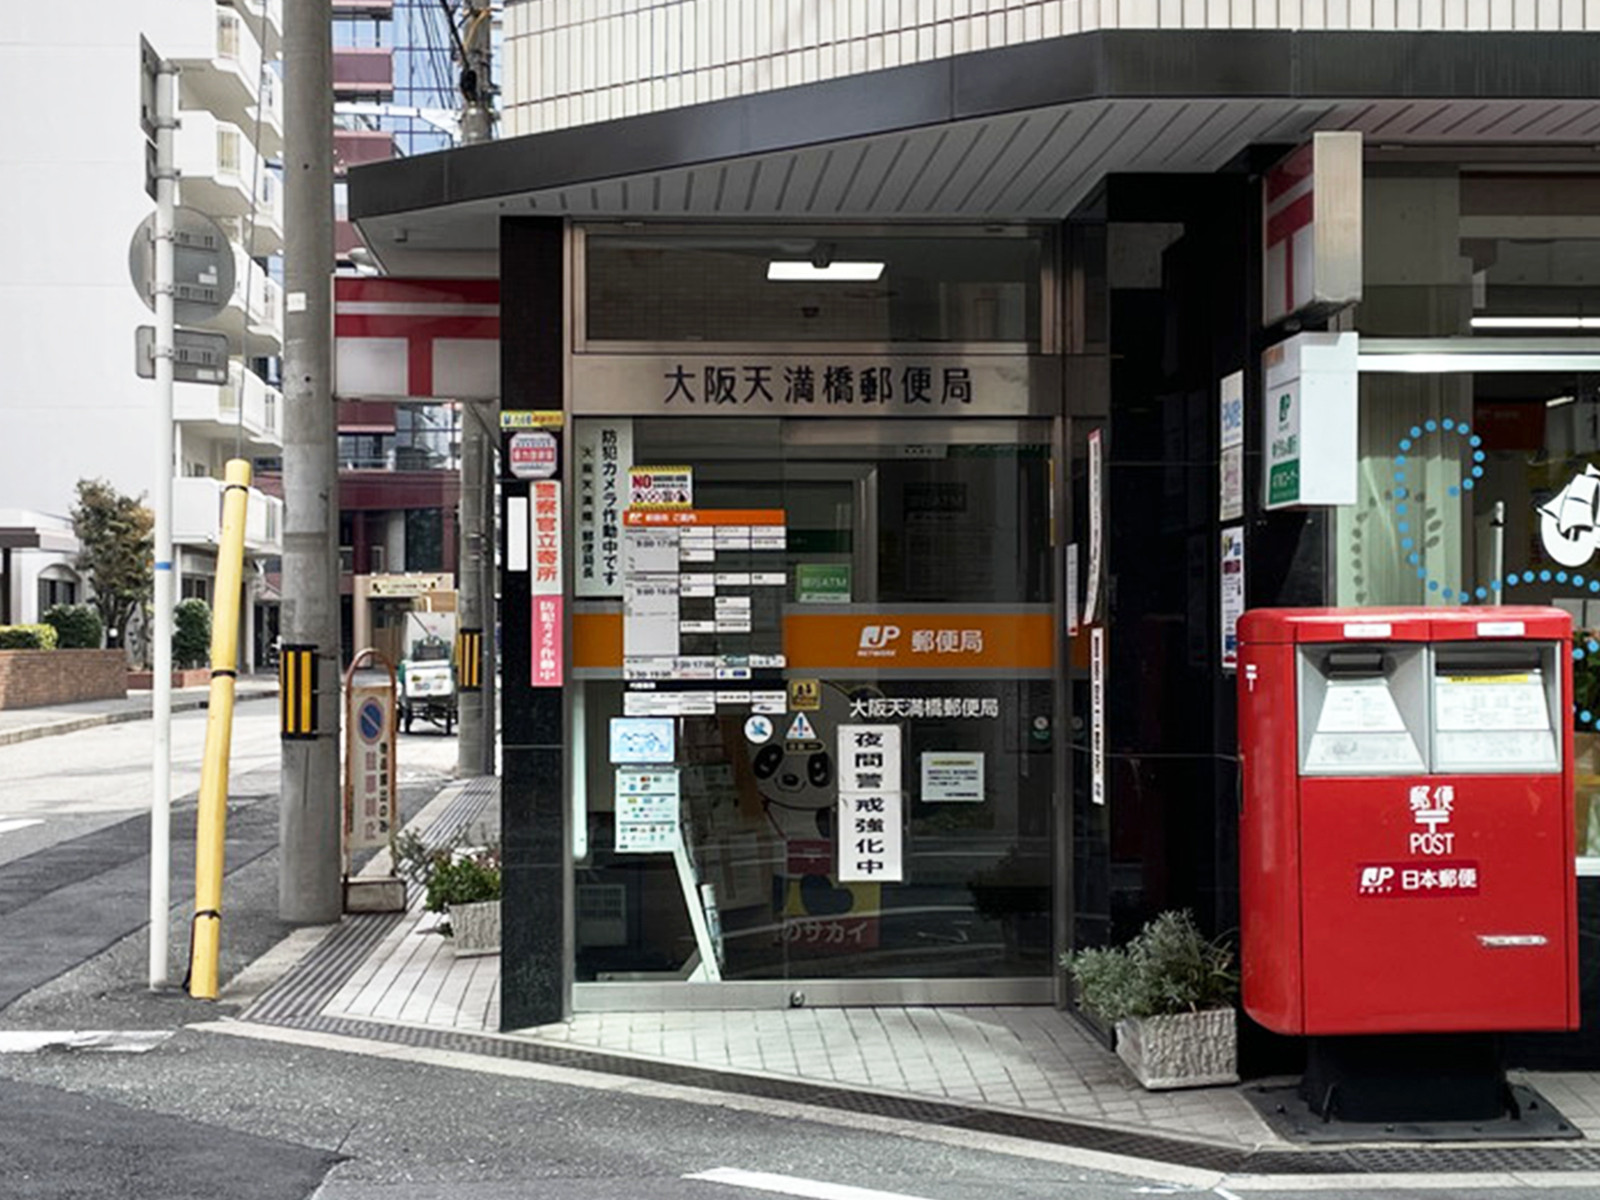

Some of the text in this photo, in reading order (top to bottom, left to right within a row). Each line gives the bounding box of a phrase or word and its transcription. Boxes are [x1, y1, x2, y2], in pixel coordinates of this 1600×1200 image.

[664, 364, 973, 404] 大阪天満橋郵便局
[602, 429, 618, 586] 防犯カメラ作動中です
[535, 483, 557, 582] 警察官立寄所
[911, 629, 983, 653] 郵便局
[849, 697, 999, 718] 大阪天満橋郵便局
[854, 731, 884, 874] 夜間警戒強化中
[1410, 785, 1454, 811] 郵便
[1410, 833, 1454, 855] POST
[1402, 868, 1477, 889] 日本郵便
